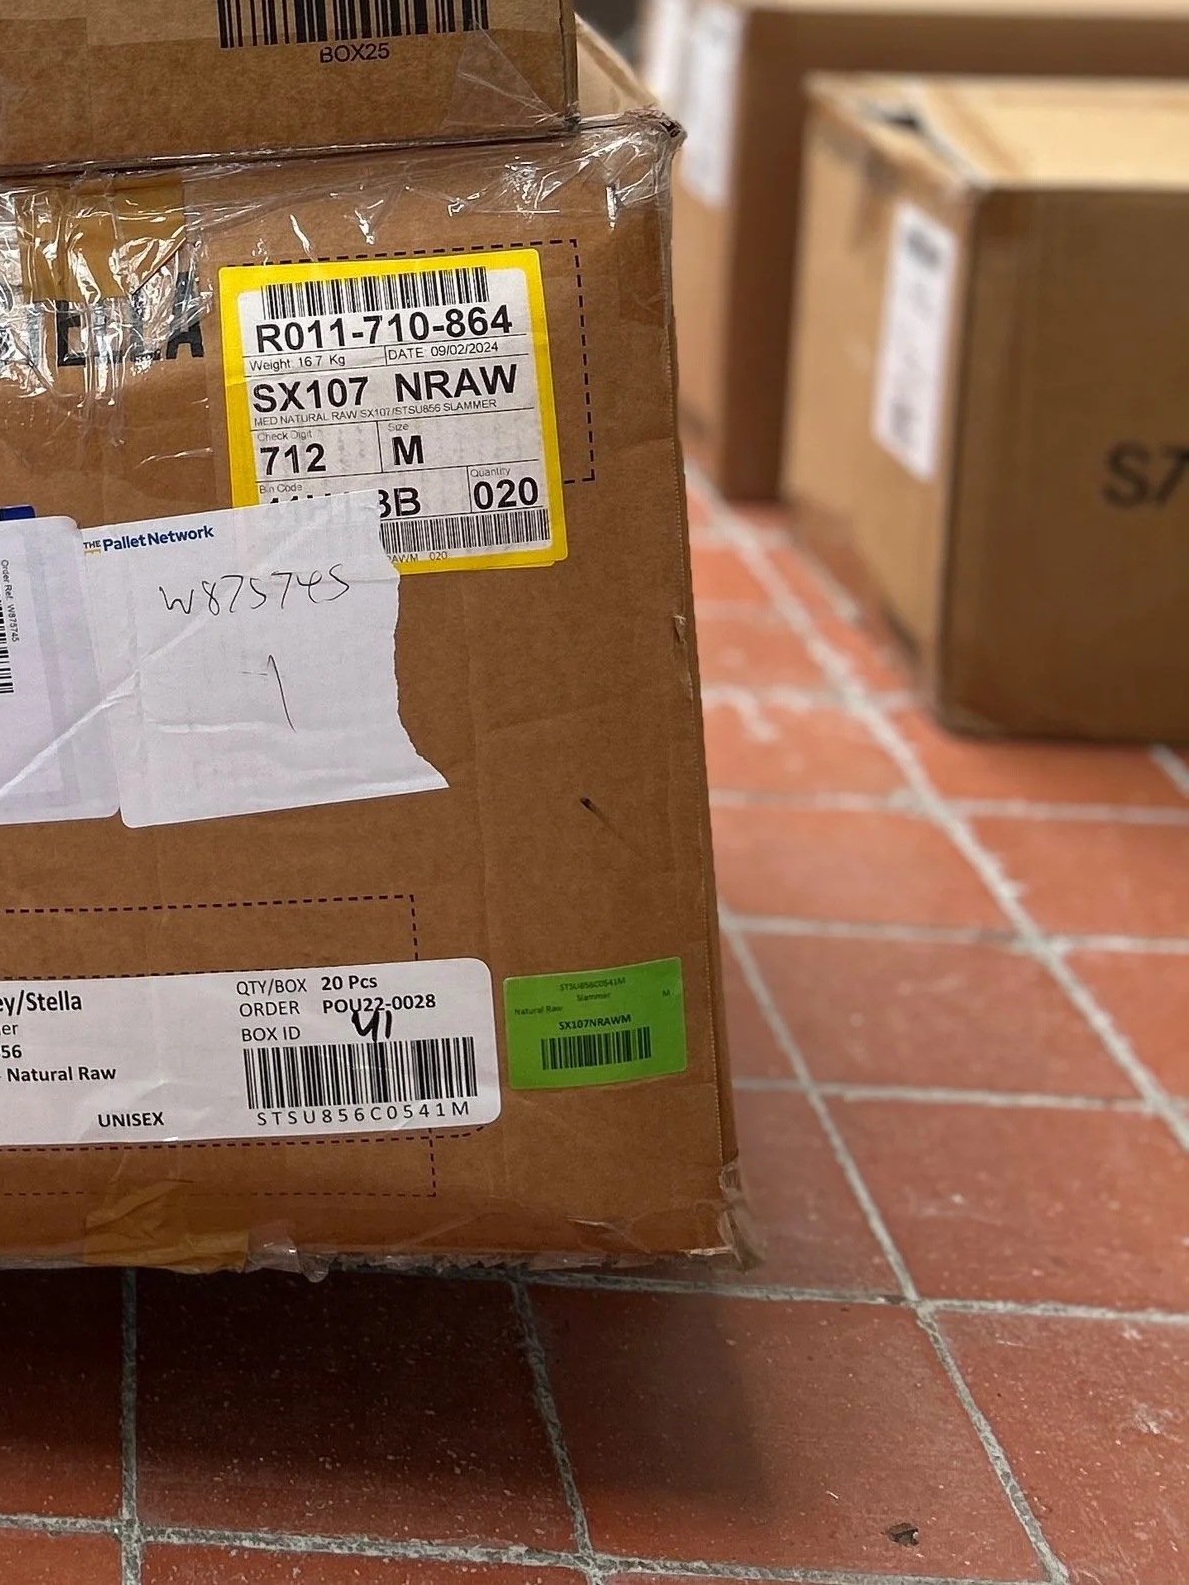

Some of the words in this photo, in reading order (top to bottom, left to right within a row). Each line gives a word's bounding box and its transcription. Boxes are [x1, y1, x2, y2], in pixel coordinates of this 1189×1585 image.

[319, 43, 390, 63] BOX25
[256, 304, 513, 354] R011-710-864
[430, 341, 499, 357] 09/02/2024
[329, 354, 346, 367] Kg
[253, 376, 369, 414] SX107
[395, 364, 517, 403] NRAW
[254, 417, 279, 428] MED
[280, 412, 328, 425] NATURAL
[331, 410, 358, 421] RAW
[360, 404, 441, 419] SX107/STSU856
[443, 399, 497, 412] SLAMMER
[388, 421, 409, 433] Size
[257, 431, 288, 443] Check
[290, 430, 313, 442] Digit
[391, 435, 424, 466] M
[260, 442, 326, 476] 712
[470, 467, 511, 479] Quantity
[277, 482, 303, 493] Code
[473, 476, 539, 510] 020
[83, 539, 102, 550] THE
[429, 550, 448, 561] 020
[1, 558, 12, 583] Order
[7, 603, 20, 643] W875745
[236, 978, 307, 996] QTY/BOX
[321, 976, 343, 991] 20
[348, 975, 378, 990] Pcs
[662, 989, 671, 998] M
[577, 992, 611, 1002] Slammer
[239, 1001, 300, 1017] ORDER
[322, 994, 436, 1014] POU22-0028
[515, 1005, 544, 1015] Natural
[546, 1005, 563, 1014] Raw
[558, 1014, 631, 1030] SX107NRAWM
[241, 1027, 278, 1042] BOX
[283, 1026, 301, 1041] ID
[7, 1066, 73, 1082] Natural
[78, 1065, 117, 1081] Raw
[97, 1111, 165, 1128] UNISEX
[257, 1101, 470, 1126] STSU856C0541M
